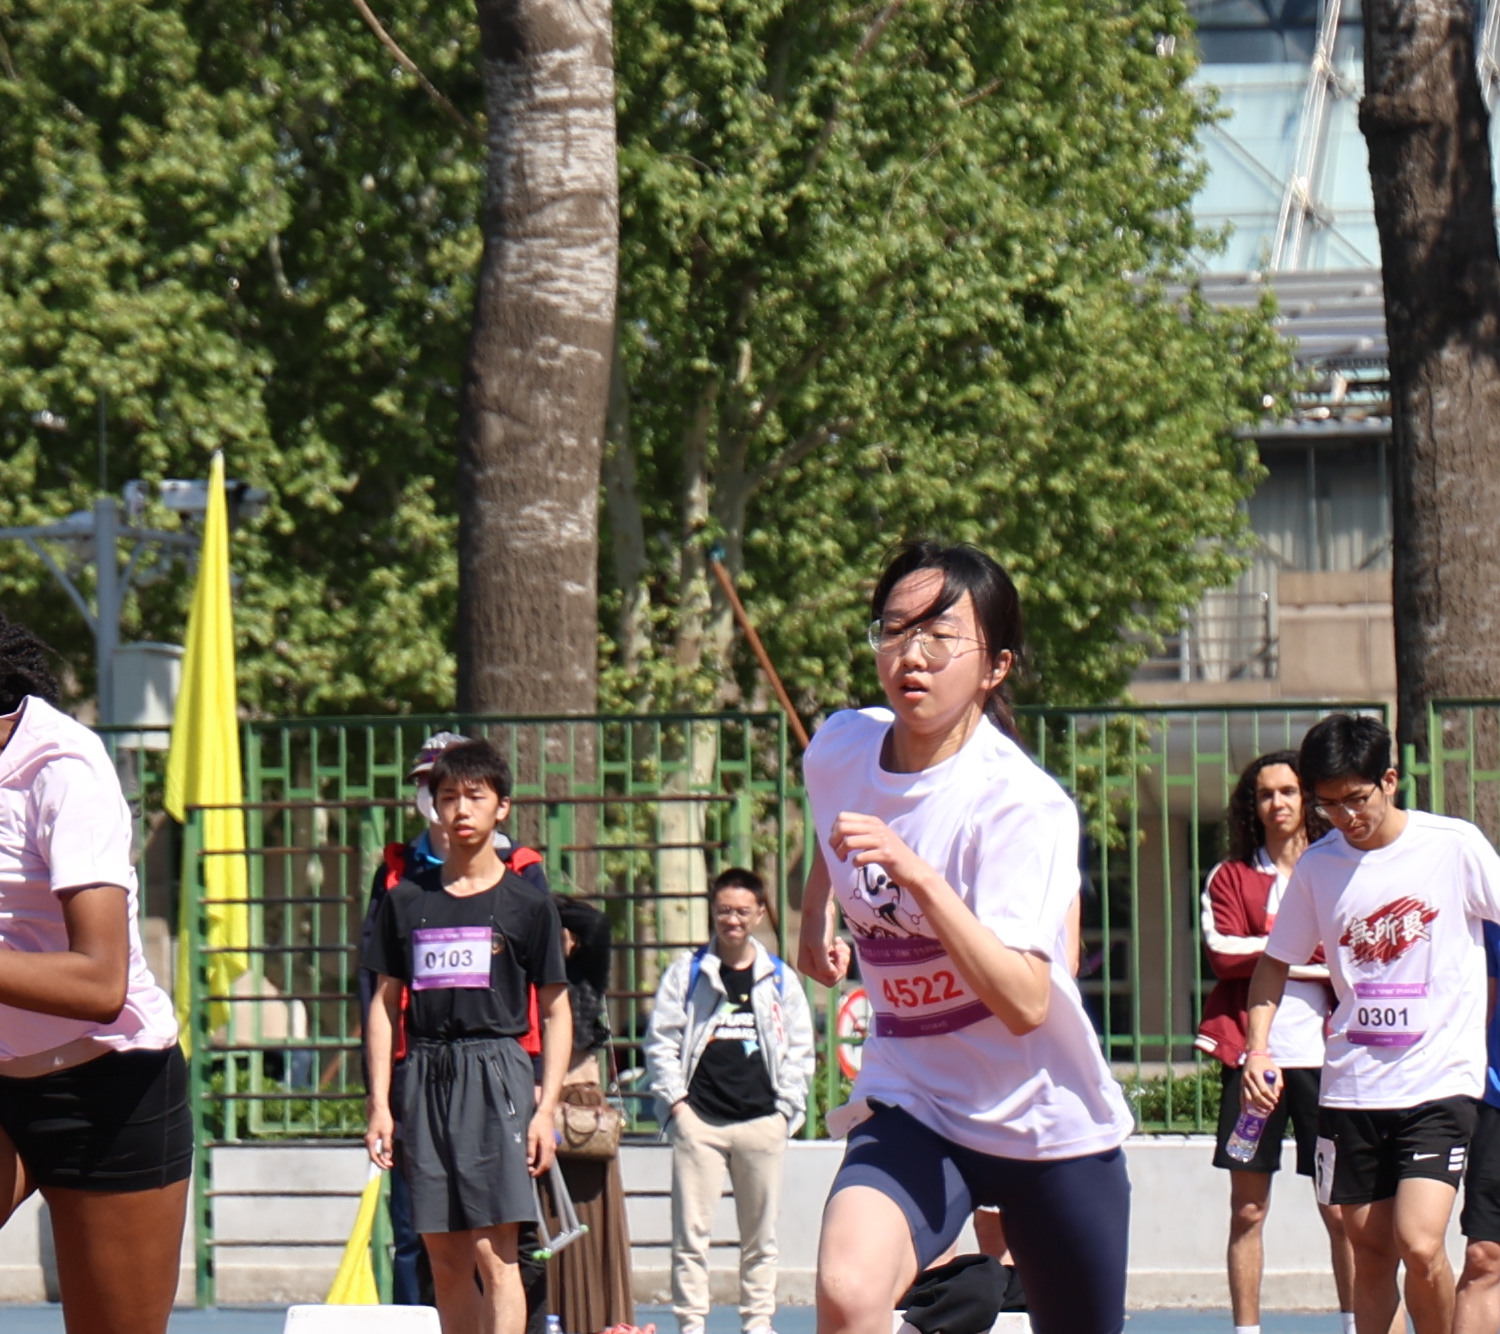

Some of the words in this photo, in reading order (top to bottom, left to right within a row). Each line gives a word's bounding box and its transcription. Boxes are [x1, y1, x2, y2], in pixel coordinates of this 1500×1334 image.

[1348, 910, 1431, 947] 無所畏
[425, 949, 473, 969] 0103
[882, 970, 964, 1008] 4522
[1358, 1007, 1409, 1026] 0301
